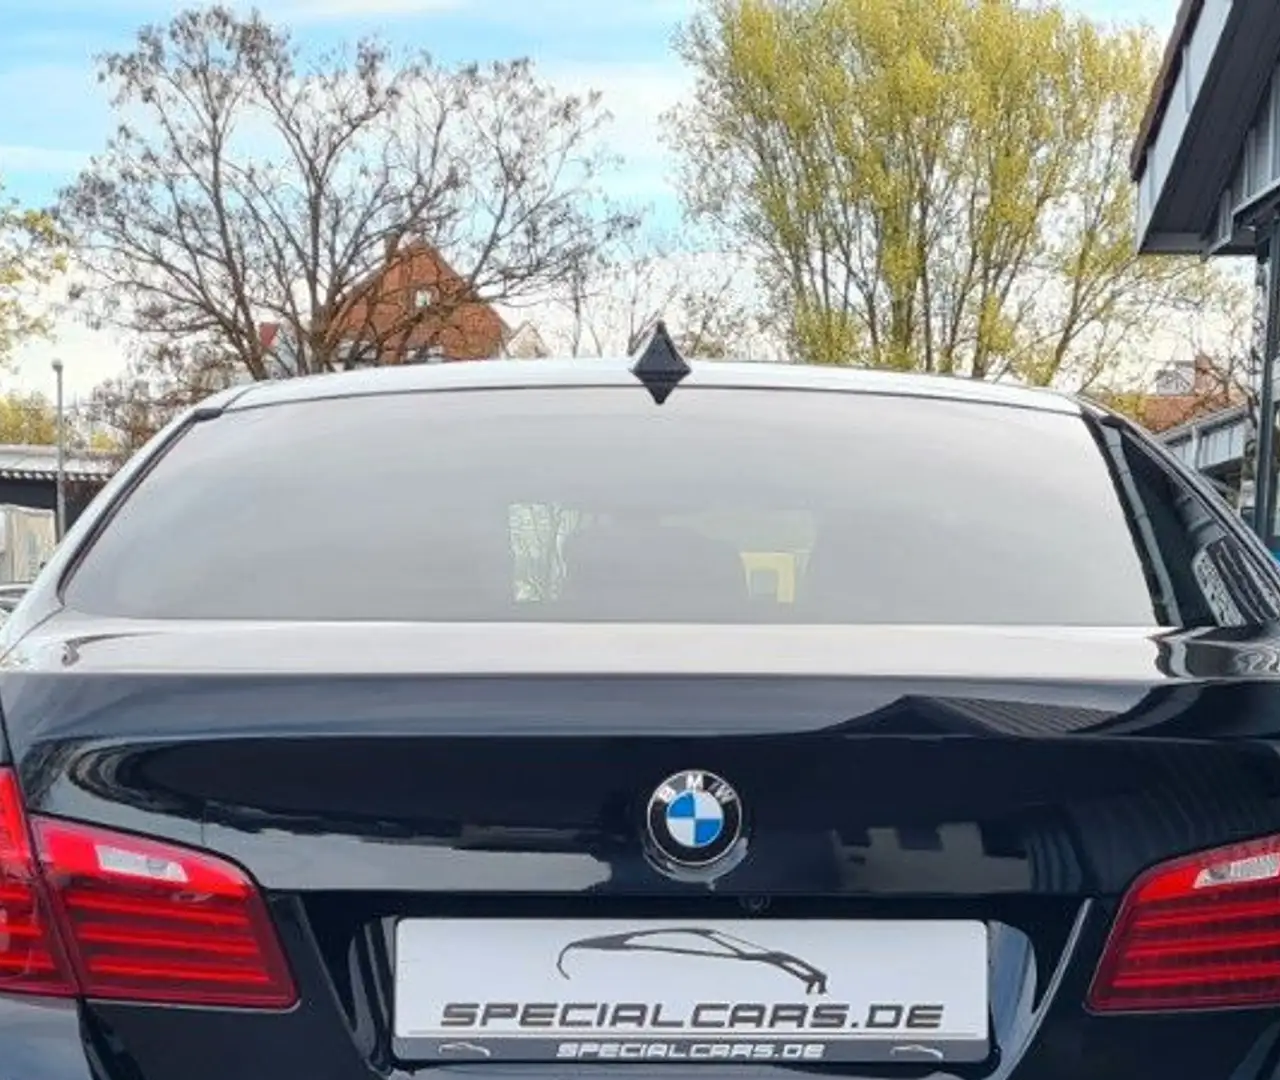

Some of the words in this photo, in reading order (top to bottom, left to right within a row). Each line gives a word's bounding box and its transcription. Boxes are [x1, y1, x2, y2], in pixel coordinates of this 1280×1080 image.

[657, 772, 738, 804] BMW
[440, 1002, 945, 1029] SPECIALCARS.DE
[556, 1043, 825, 1059] SPECIALCARS.DE
